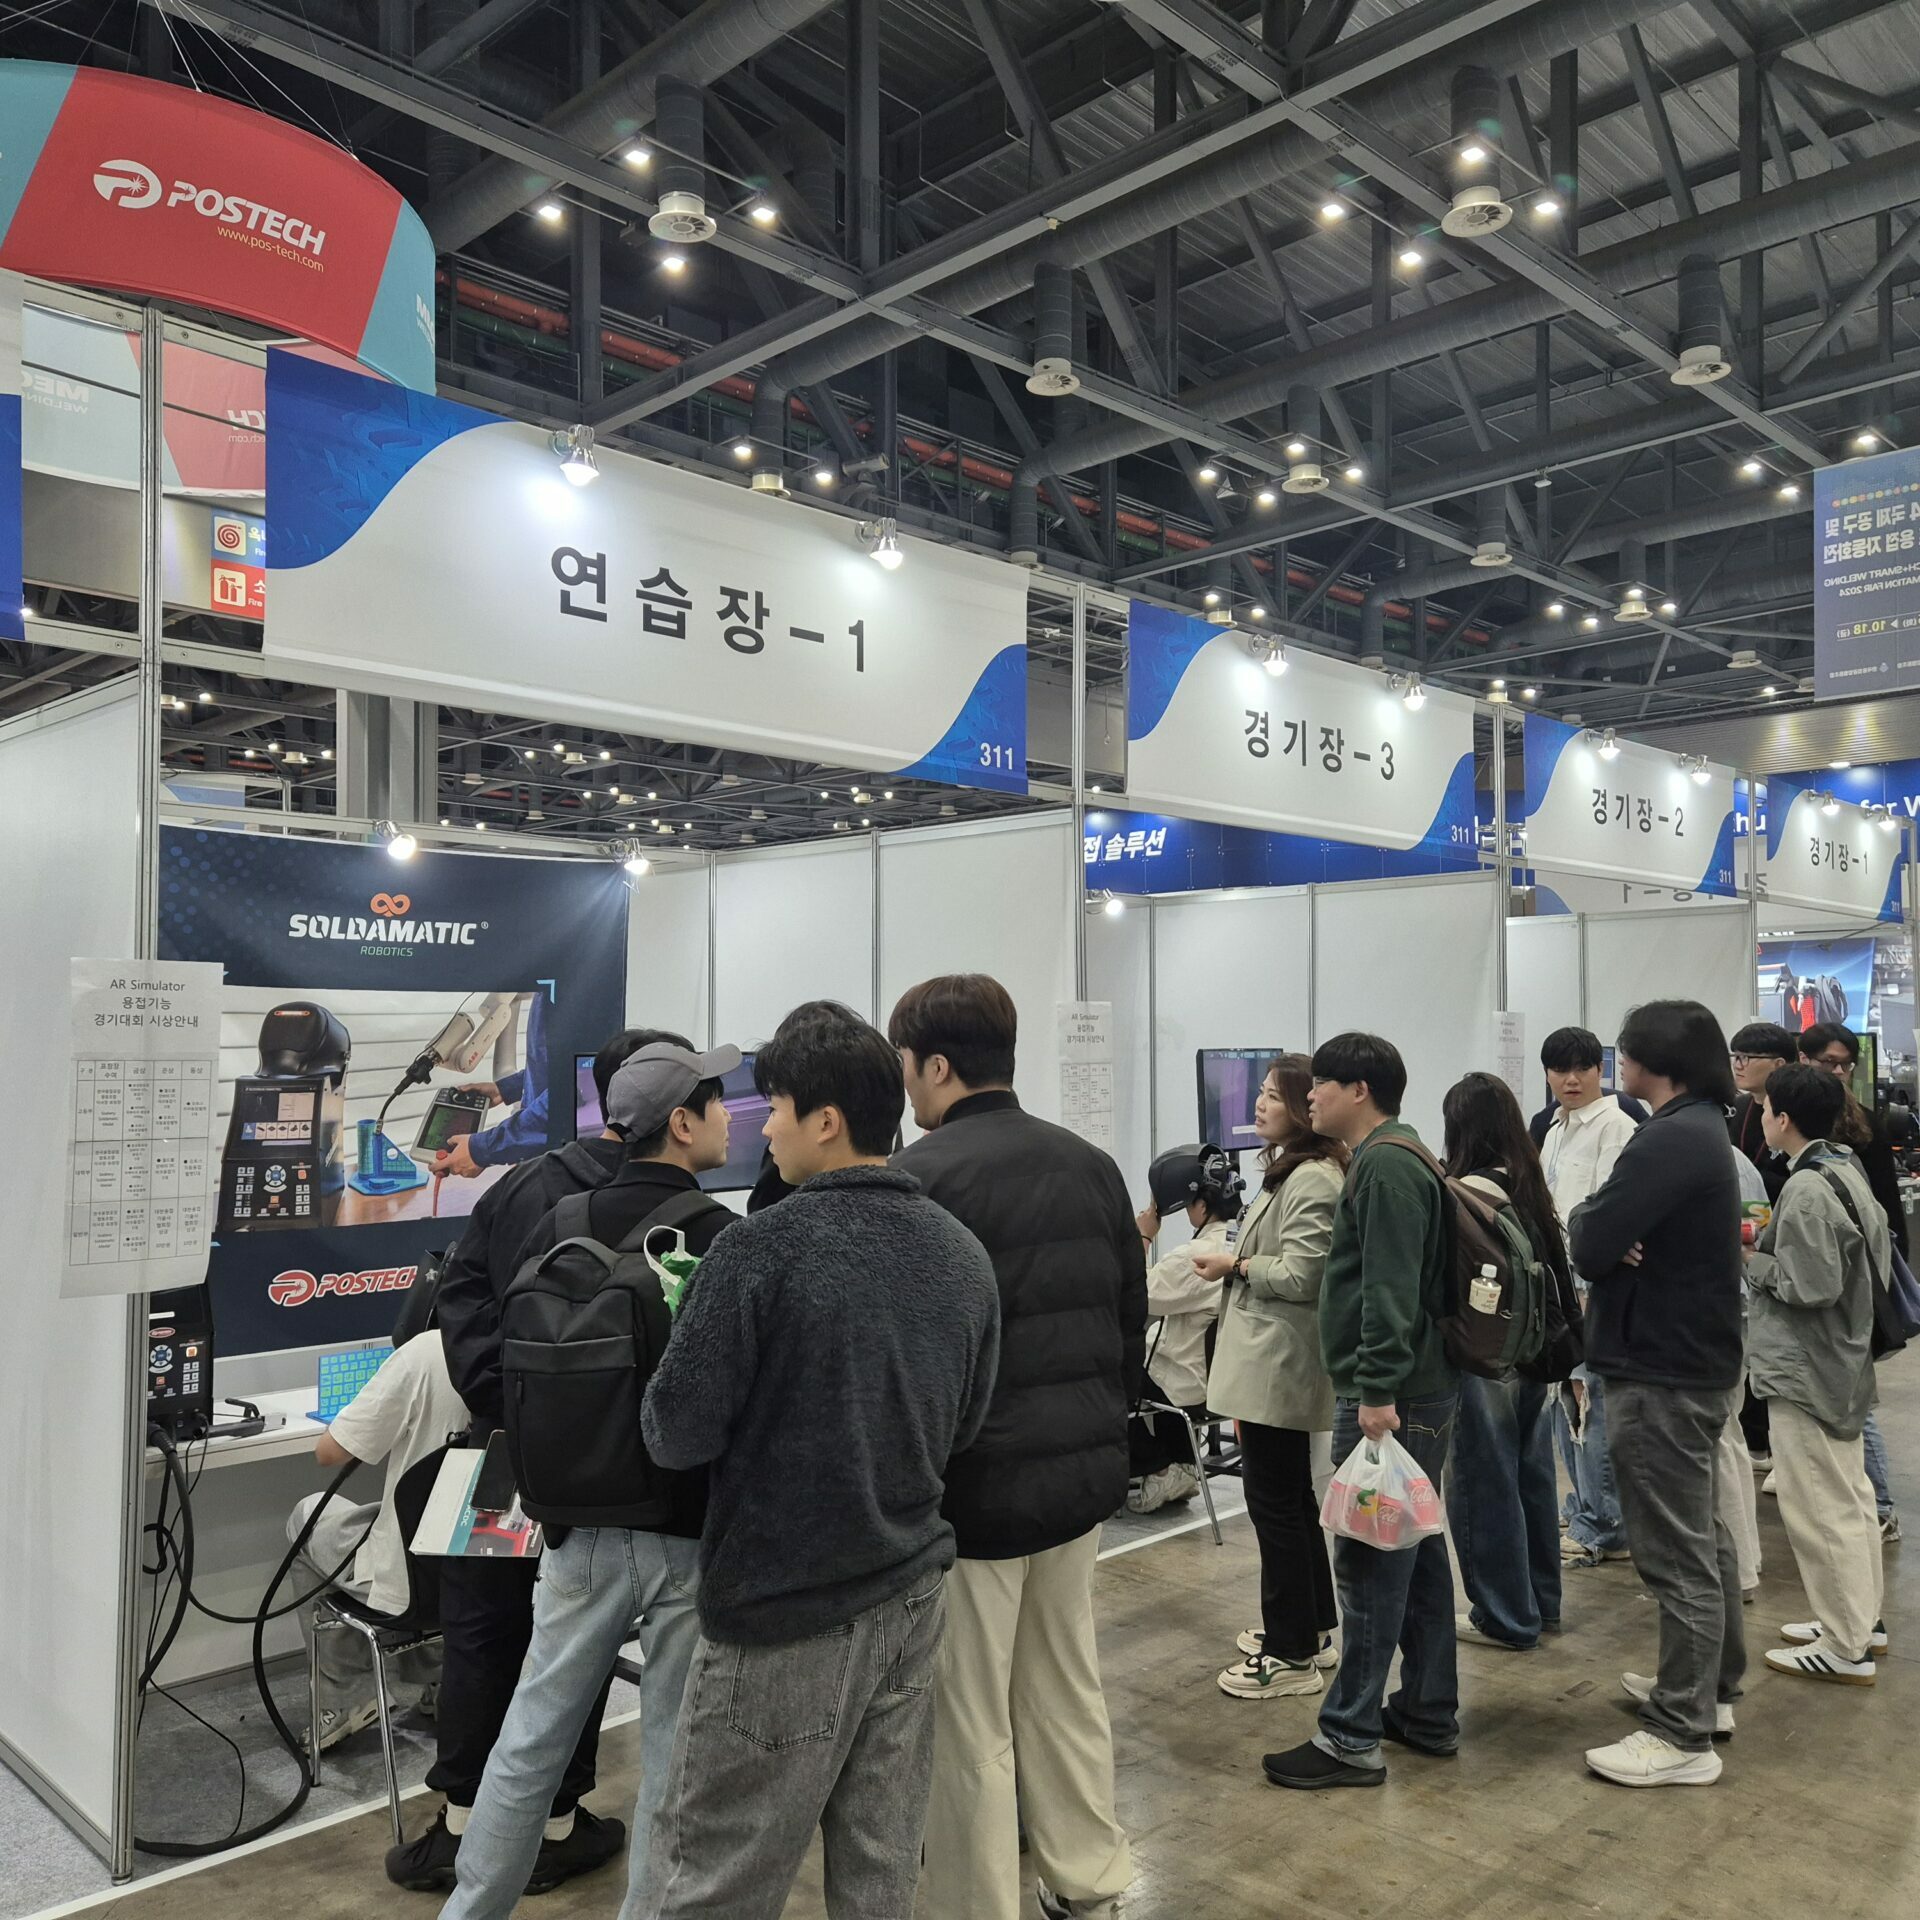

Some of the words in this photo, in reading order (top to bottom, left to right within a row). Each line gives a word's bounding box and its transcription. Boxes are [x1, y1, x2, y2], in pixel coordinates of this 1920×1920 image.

[167, 180, 326, 255] POSTECH
[217, 226, 324, 273] www.pos-tech.com
[551, 546, 865, 673] 연습장-1
[980, 742, 1013, 770] 311
[1244, 709, 1395, 781] 경기장-3
[1592, 788, 1685, 838] 경기장-2
[1105, 827, 1167, 861] 솔루션
[1451, 824, 1469, 844] 311
[1809, 836, 1869, 875] 경기장-1
[1718, 869, 1732, 884] 311
[360, 946, 414, 957] ROBOTICS
[110, 979, 127, 990] AR
[130, 979, 186, 992] Simulator
[122, 996, 172, 1010] 용접기능
[94, 1013, 144, 1027] 경기대회
[149, 1015, 199, 1028] 시상안내
